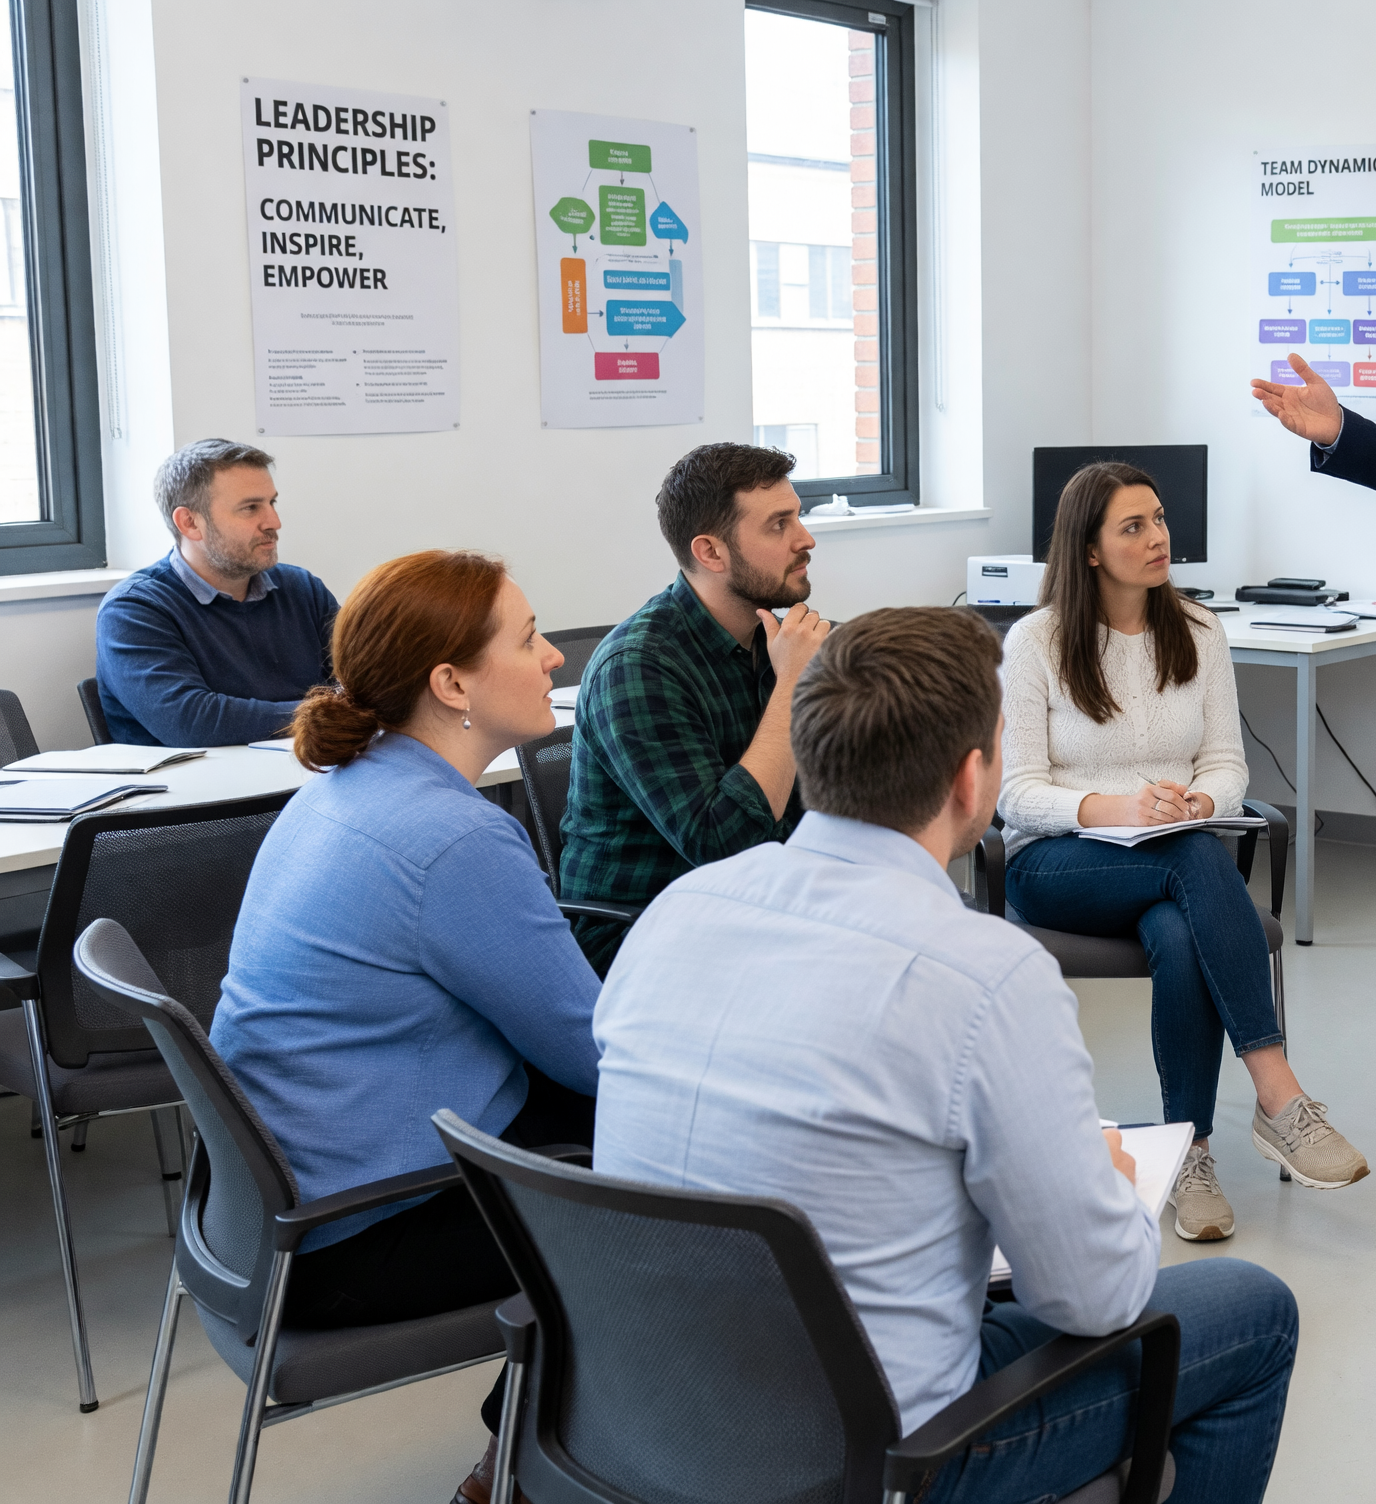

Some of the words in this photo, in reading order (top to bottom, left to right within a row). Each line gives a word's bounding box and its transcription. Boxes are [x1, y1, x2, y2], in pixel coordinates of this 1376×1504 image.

[254, 97, 437, 142] LEADERSHIP
[256, 137, 437, 181] PRINCIPLES:
[1260, 159, 1303, 176] TEAM
[1260, 180, 1315, 197] MODEL
[259, 197, 446, 234] COMMUNICATE,
[261, 231, 364, 261] INSPIRE,
[263, 264, 389, 291] EMPOWER
